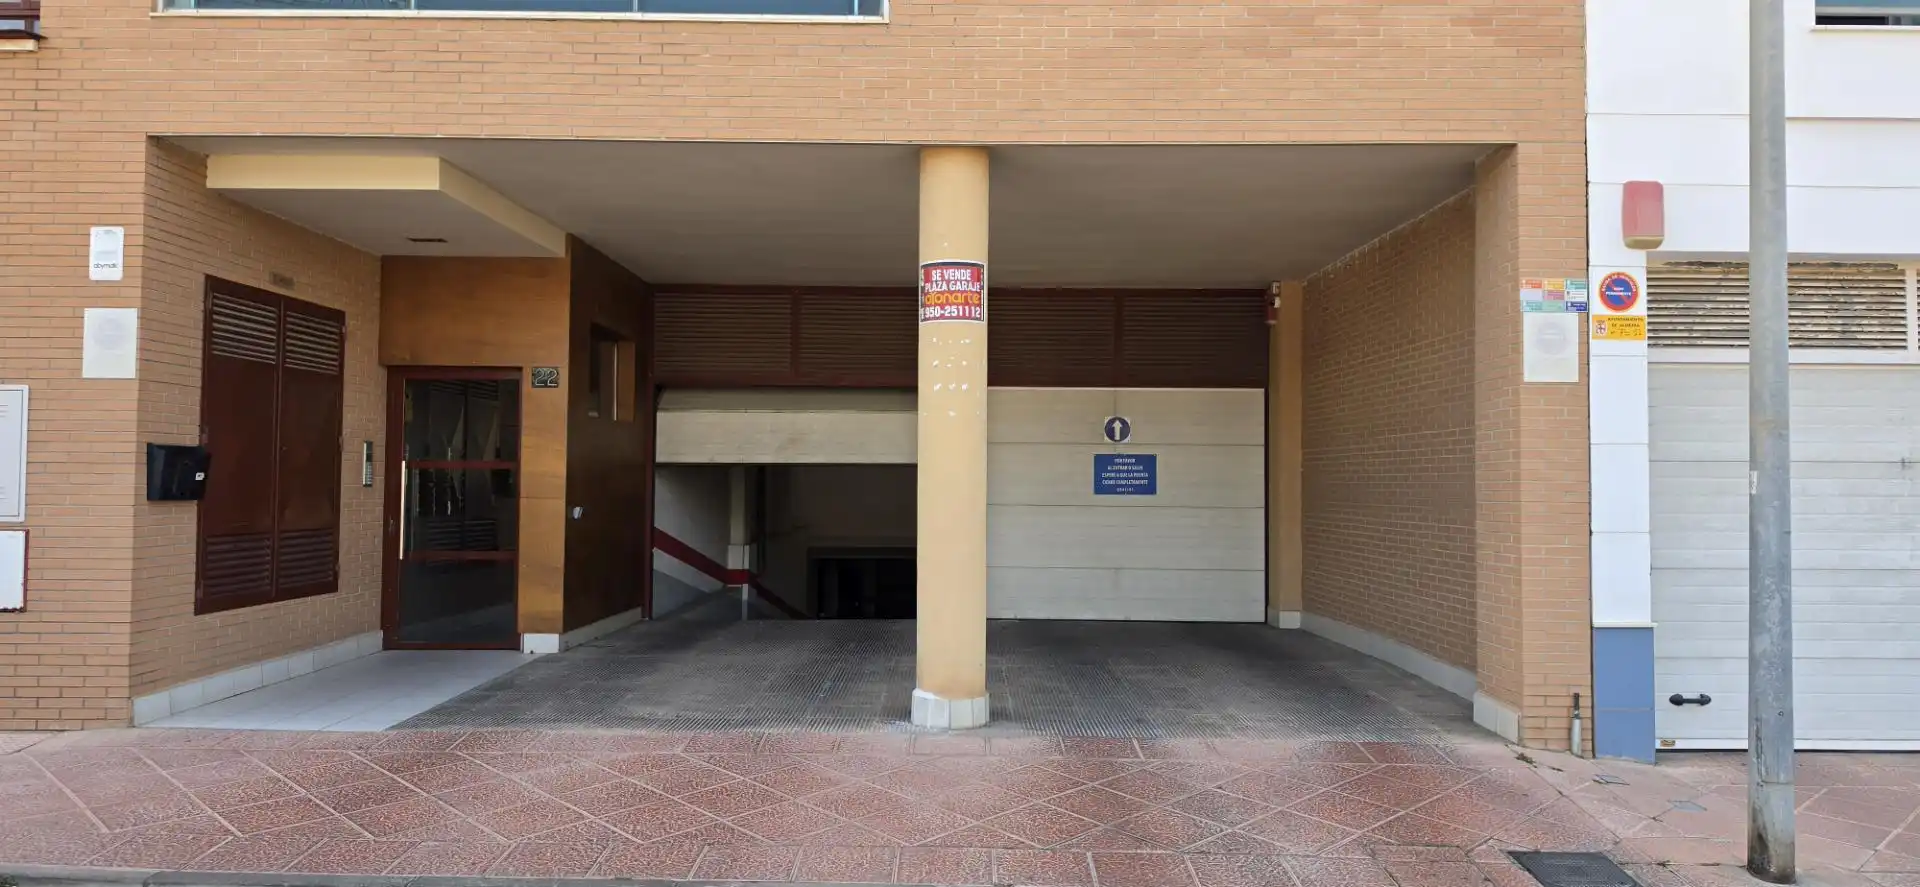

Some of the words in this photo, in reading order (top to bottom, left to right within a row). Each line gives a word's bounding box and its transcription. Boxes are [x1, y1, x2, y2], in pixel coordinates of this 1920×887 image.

[932, 270, 942, 280] SE
[944, 269, 971, 280] VENDE
[925, 281, 948, 292] PLAZA
[949, 281, 980, 292] GARAJE
[925, 305, 980, 318] 950-251112
[535, 368, 558, 386] 22
